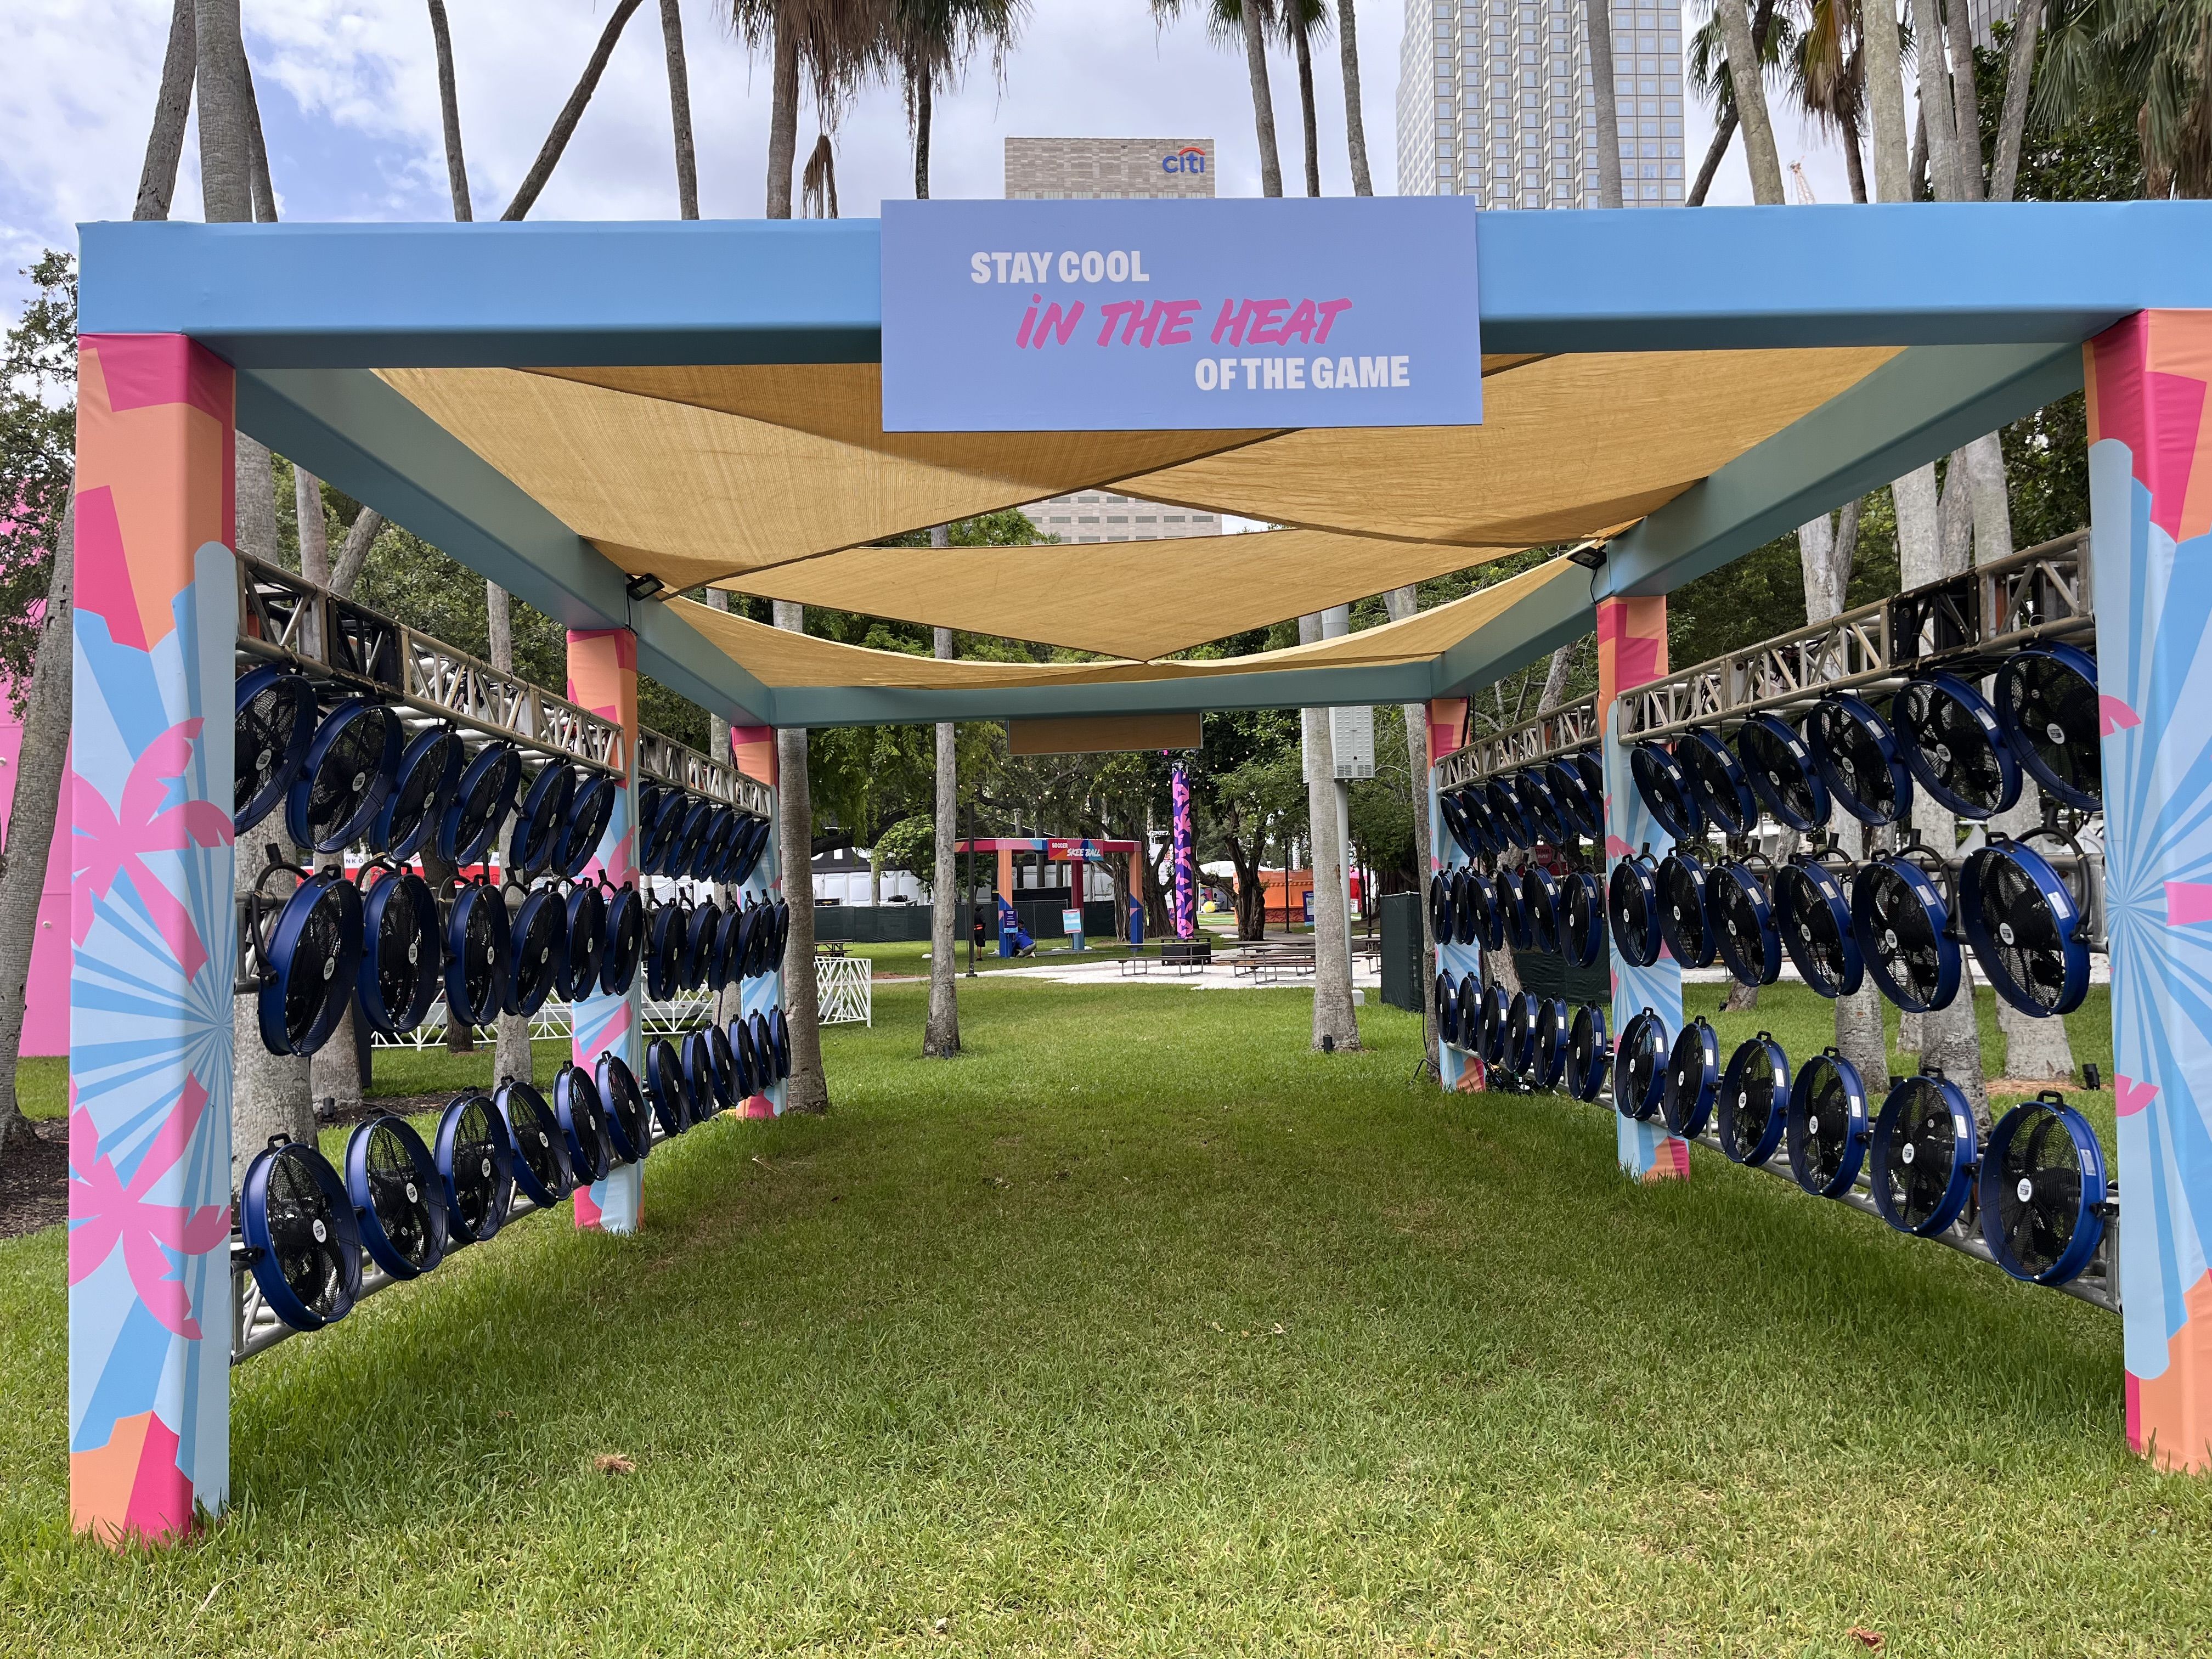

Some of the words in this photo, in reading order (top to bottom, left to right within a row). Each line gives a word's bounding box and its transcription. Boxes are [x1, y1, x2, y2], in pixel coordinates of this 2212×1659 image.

[1163, 153, 1205, 173] citi
[970, 251, 1053, 284] STAY
[1058, 250, 1150, 283] COOL
[1097, 299, 1202, 348] THE
[1210, 298, 1353, 348] HEAT
[1195, 358, 1237, 391] OF
[1240, 357, 1306, 390] THE
[1311, 355, 1410, 389] GAME
[1066, 848, 1084, 856] SKEE
[1085, 848, 1101, 857] BALL
